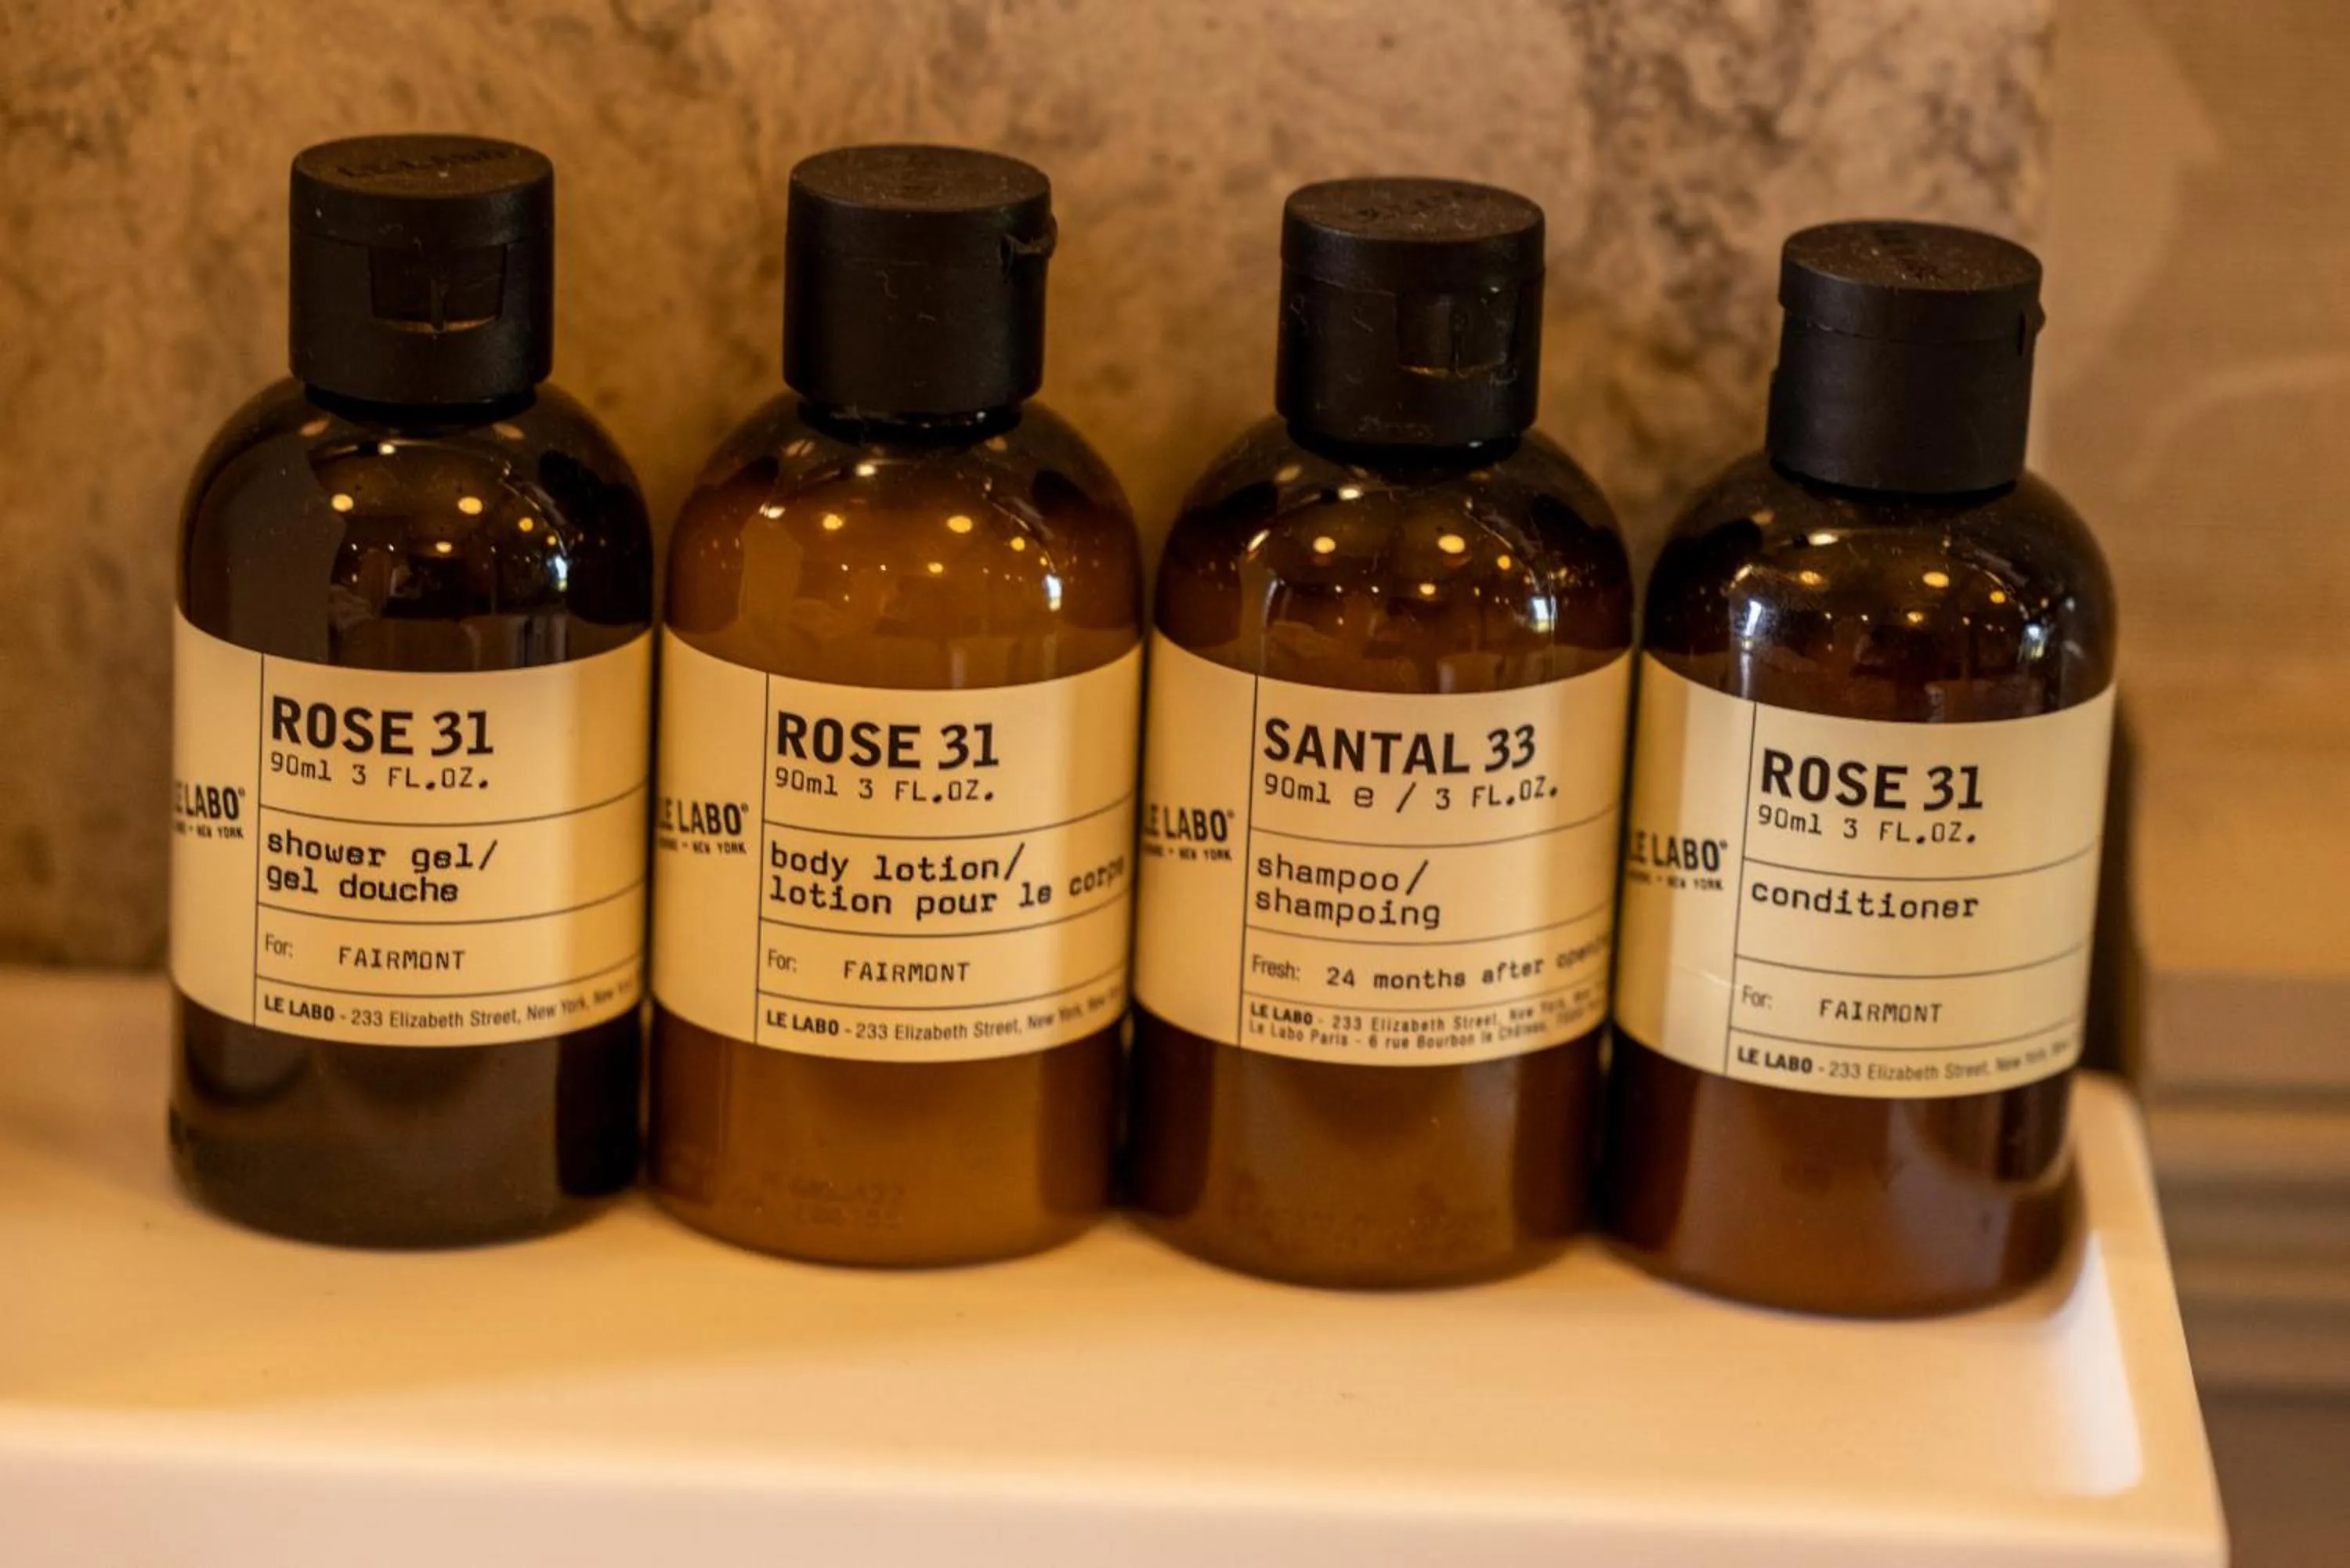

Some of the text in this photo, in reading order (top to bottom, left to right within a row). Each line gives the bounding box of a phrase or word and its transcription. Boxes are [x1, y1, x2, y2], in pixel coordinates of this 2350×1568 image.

[273, 695, 494, 757] ROSE 31
[777, 710, 999, 771] ROSE 31
[1264, 717, 1536, 775] SANTAL 33
[271, 751, 489, 790] 90ml 3 FL.OZ.
[776, 766, 994, 804] 90ml 3 FL.OZ.
[1762, 747, 1983, 811] ROSE 31
[1264, 772, 1331, 804] 90ml
[1396, 782, 1416, 813] /
[1436, 788, 1450, 810] 3
[1472, 775, 1558, 807] FL.OZ.
[1758, 804, 1976, 844] 90ml 3 FL.OZ.
[267, 829, 497, 873] shower gel/
[771, 840, 1025, 883] body lotion/
[266, 865, 459, 902] gel douche
[1257, 853, 1429, 896] shampoo/
[770, 875, 892, 915] lotion
[916, 892, 997, 921] pour
[1018, 881, 1053, 908] le
[1255, 887, 1441, 930] shampoing
[1751, 882, 1979, 919] conditioner
[266, 933, 465, 970] For: FAIRMONT
[768, 948, 971, 983] For: FAIRMONT
[1252, 953, 1300, 981] Fresh:
[1326, 966, 1356, 988] 24
[1373, 968, 1466, 990] months
[1482, 958, 1544, 984] after
[264, 995, 284, 1013] LE
[290, 1000, 335, 1022] LABO
[351, 1010, 383, 1028] 233
[390, 1010, 464, 1028] Elizabeth
[470, 1009, 521, 1028] Street,
[527, 1004, 557, 1021] New
[1250, 1002, 1267, 1018] LE
[1272, 1006, 1313, 1025] LABO
[1332, 1015, 1362, 1031] 233
[1372, 1016, 1444, 1032] Elizabeth
[1741, 985, 1943, 1023] For: FAIRMONT
[767, 1010, 787, 1028] LE
[792, 1015, 839, 1036] LABO
[855, 1023, 888, 1040] 233
[895, 1024, 967, 1042] Elizabeth
[973, 1017, 1022, 1039] Street,
[1249, 1020, 1264, 1035] Le
[1271, 1024, 1304, 1042] Labo
[1311, 1028, 1348, 1047] Paris
[1369, 1034, 1378, 1050] 6
[1385, 1037, 1409, 1050] rue
[1416, 1033, 1475, 1050] Bourbon
[1737, 1046, 1759, 1064] LE
[1765, 1051, 1813, 1074] LABO
[1829, 1061, 1861, 1079] 233
[1867, 1063, 1939, 1081] Elizabeth
